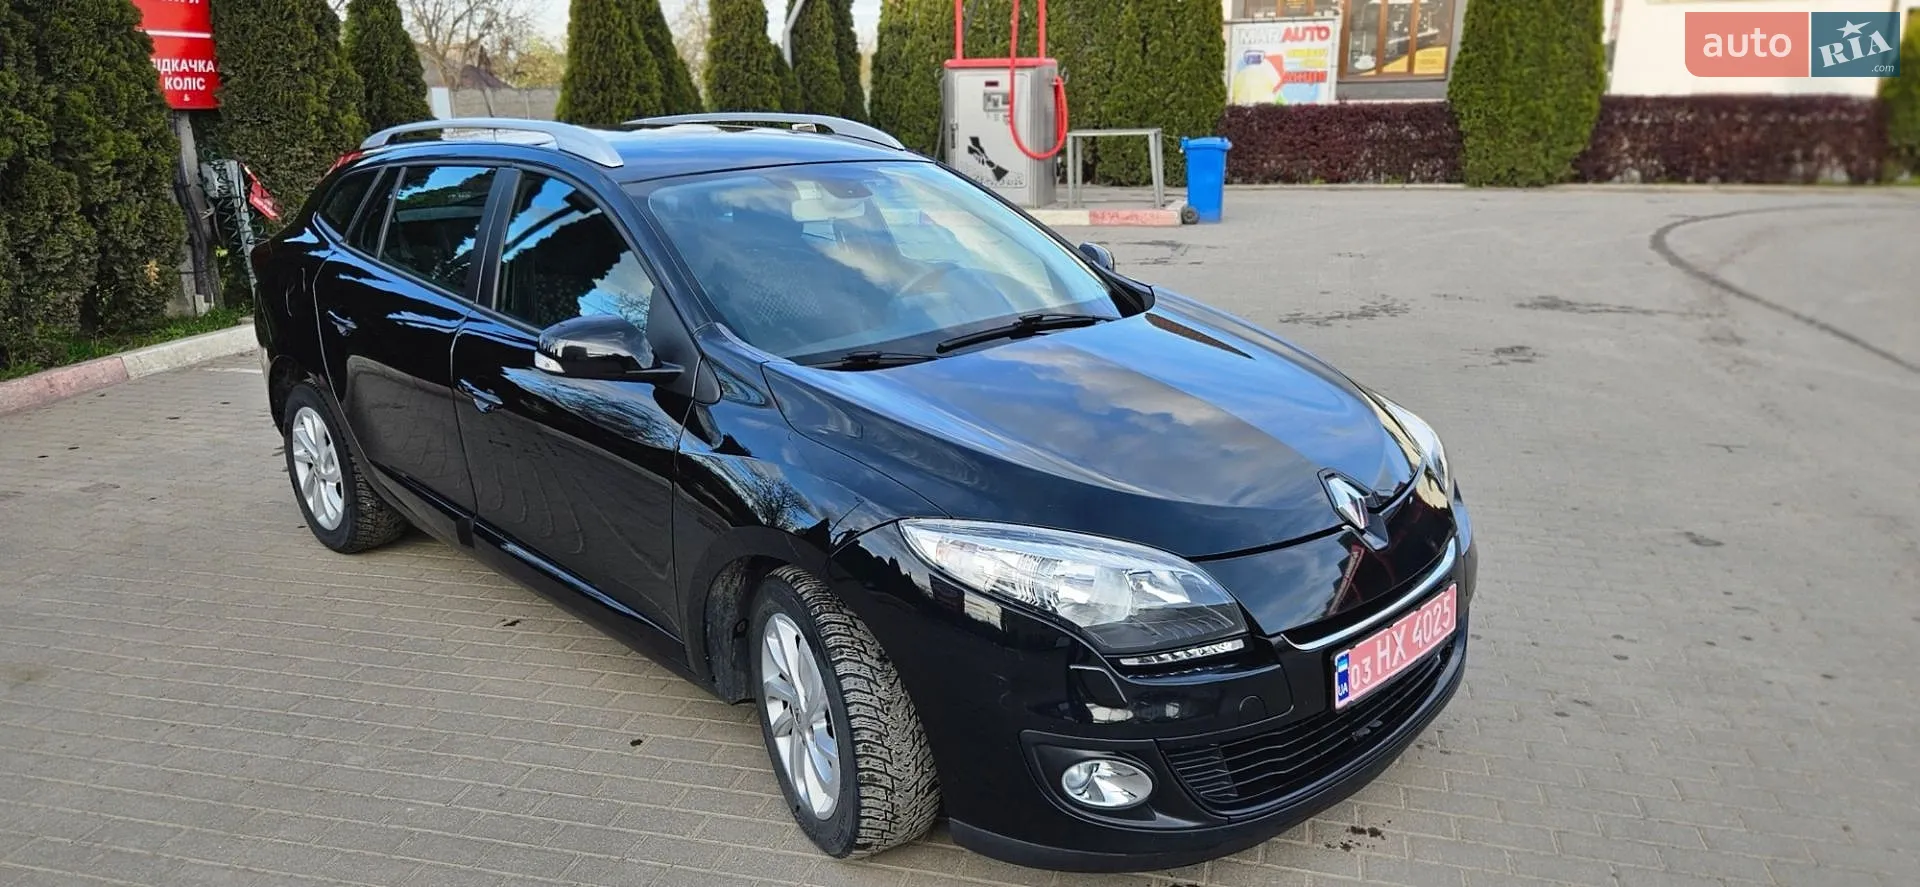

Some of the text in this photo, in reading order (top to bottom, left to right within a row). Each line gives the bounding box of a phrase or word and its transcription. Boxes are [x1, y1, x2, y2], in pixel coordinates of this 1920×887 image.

[164, 76, 206, 91] КОЛІС
[1351, 595, 1452, 690] 03 HX 4025
[1337, 683, 1348, 697] UA
